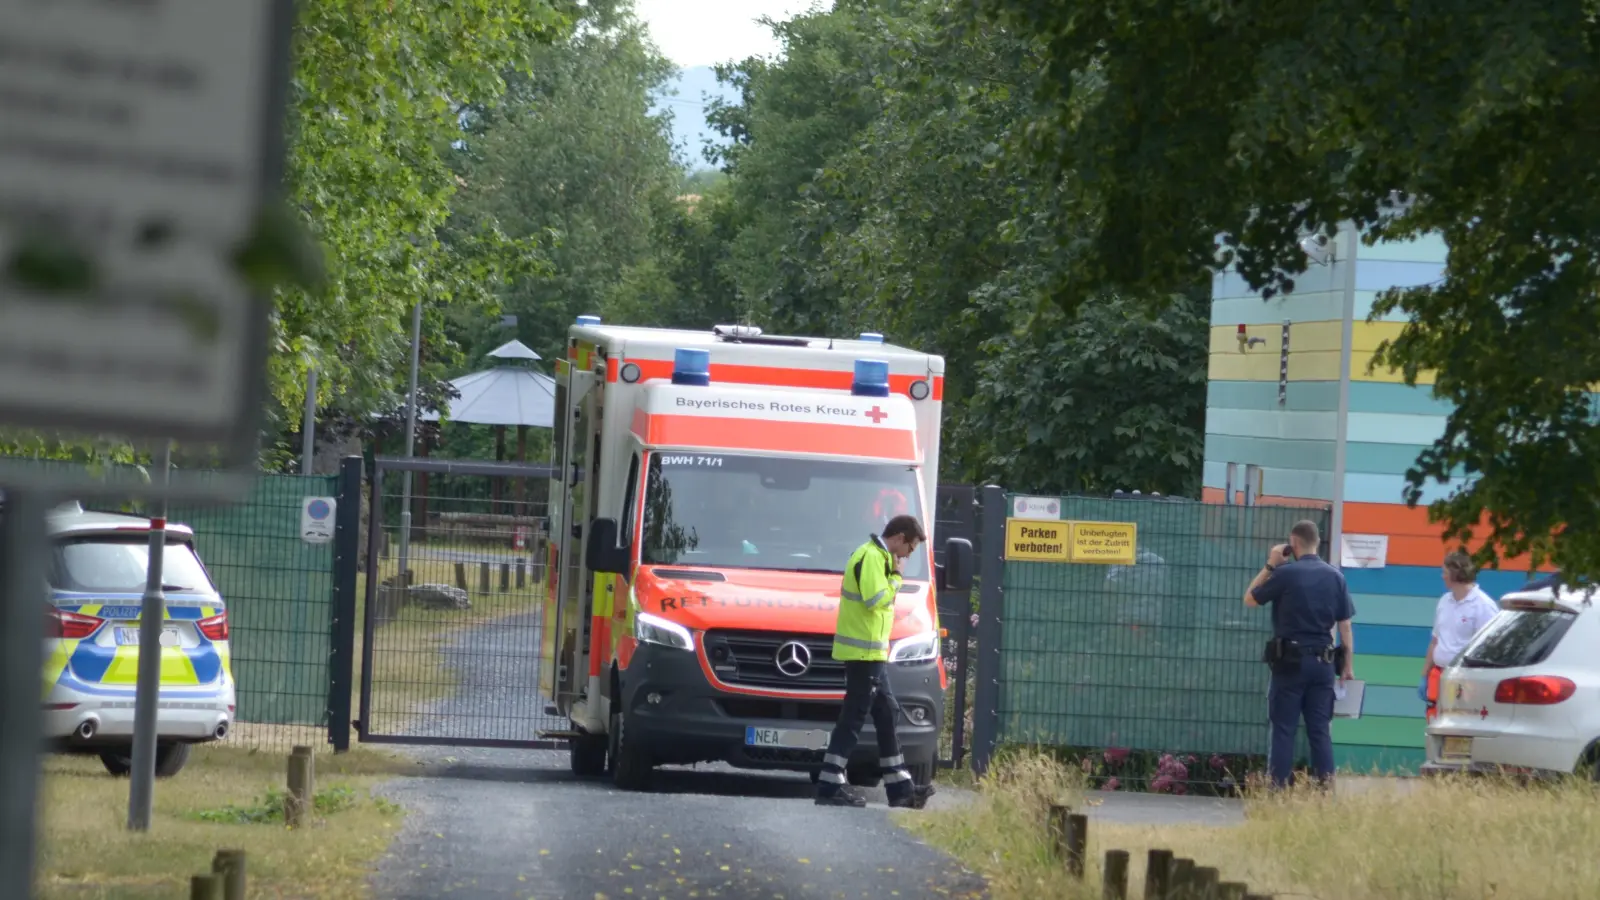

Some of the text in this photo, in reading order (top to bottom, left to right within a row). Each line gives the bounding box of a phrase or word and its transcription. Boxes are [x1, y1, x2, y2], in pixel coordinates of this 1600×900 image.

[676, 396, 858, 417] Bayerisches Rotes Kreuz
[661, 455, 723, 467] BWH 71/1
[1020, 526, 1057, 540] Parken
[1079, 528, 1128, 539] Unbefugten
[1014, 541, 1063, 555] verboten!
[1076, 538, 1130, 548] ist der Zutritt
[1082, 548, 1121, 556] verboten!
[102, 606, 139, 617] POLIZEI
[755, 729, 779, 745] NEA
